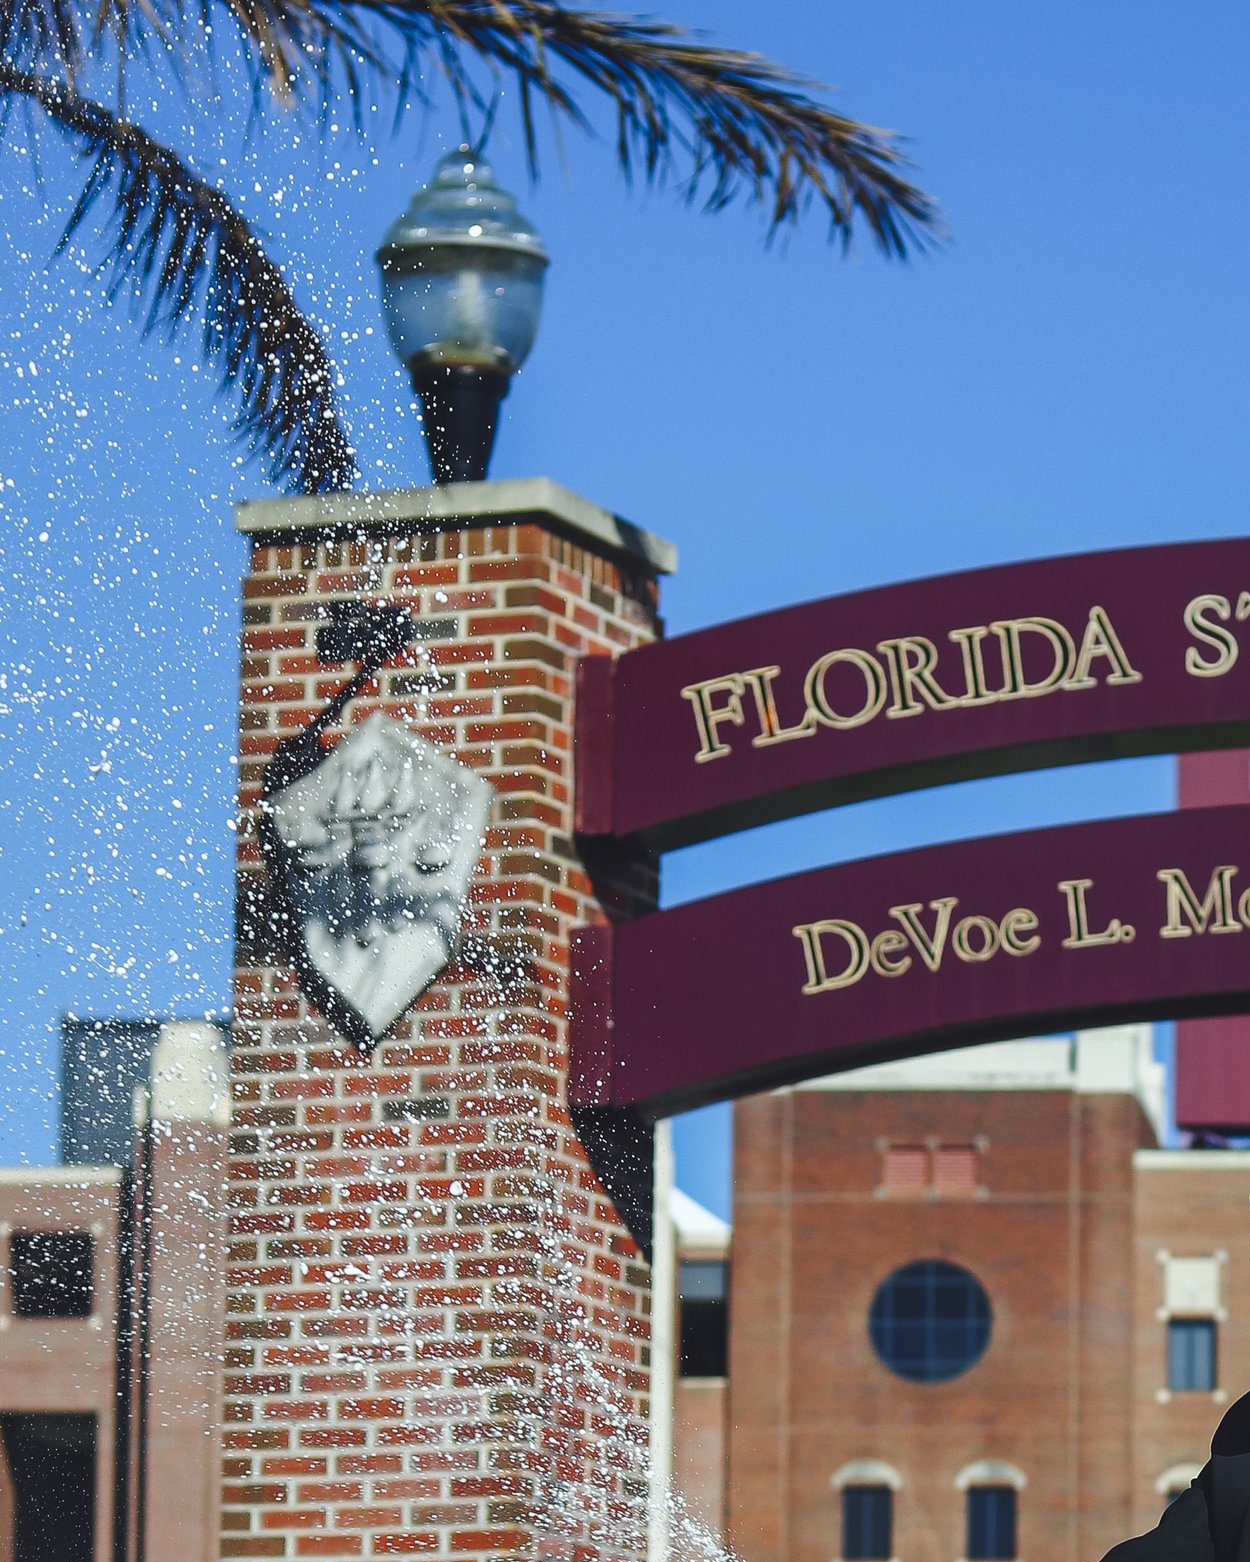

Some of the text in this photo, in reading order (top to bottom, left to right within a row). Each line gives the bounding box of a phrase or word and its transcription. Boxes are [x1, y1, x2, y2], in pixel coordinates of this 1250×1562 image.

[681, 606, 1142, 763] FLORIDA
[792, 897, 1041, 994] DeVoe
[1058, 879, 1136, 948] L.
